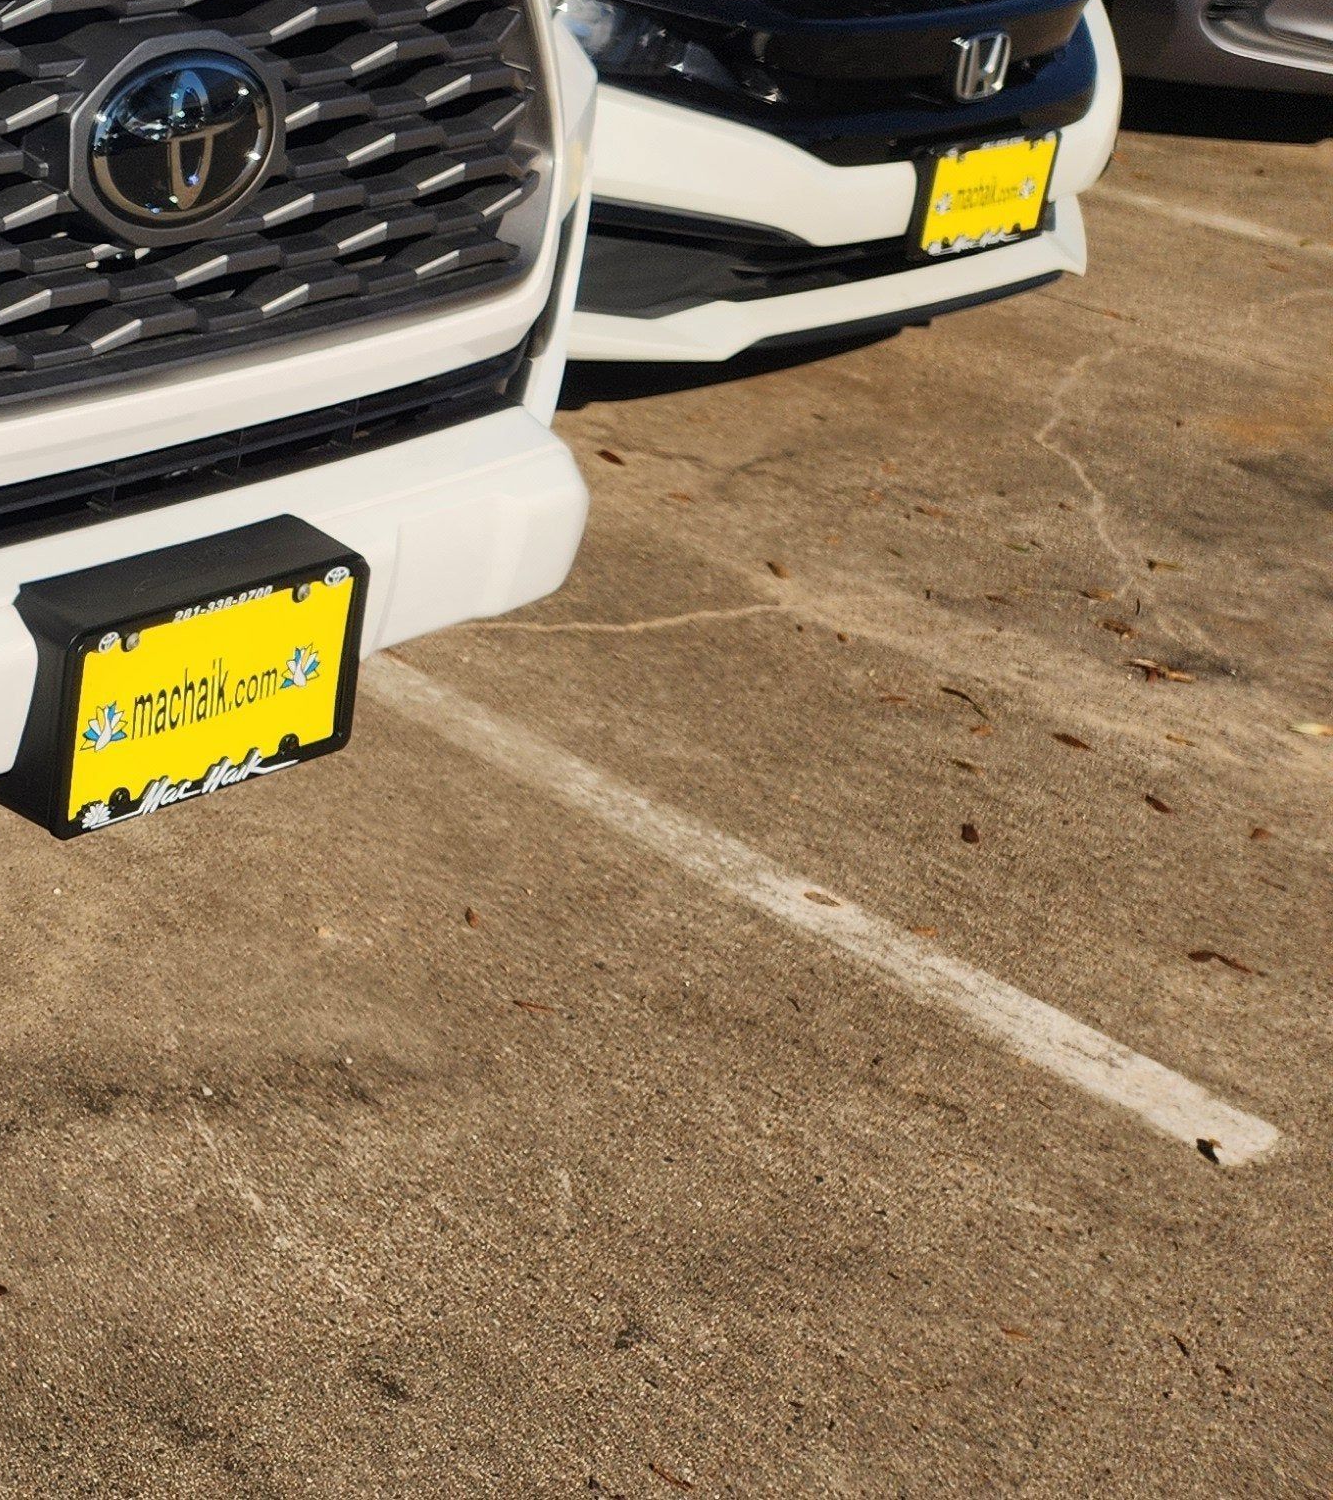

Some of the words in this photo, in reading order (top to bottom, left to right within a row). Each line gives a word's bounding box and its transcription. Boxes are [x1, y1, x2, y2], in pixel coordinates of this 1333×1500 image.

[130, 657, 278, 740] machaik.com
[140, 775, 200, 816] Mac
[200, 748, 279, 794] Haik
